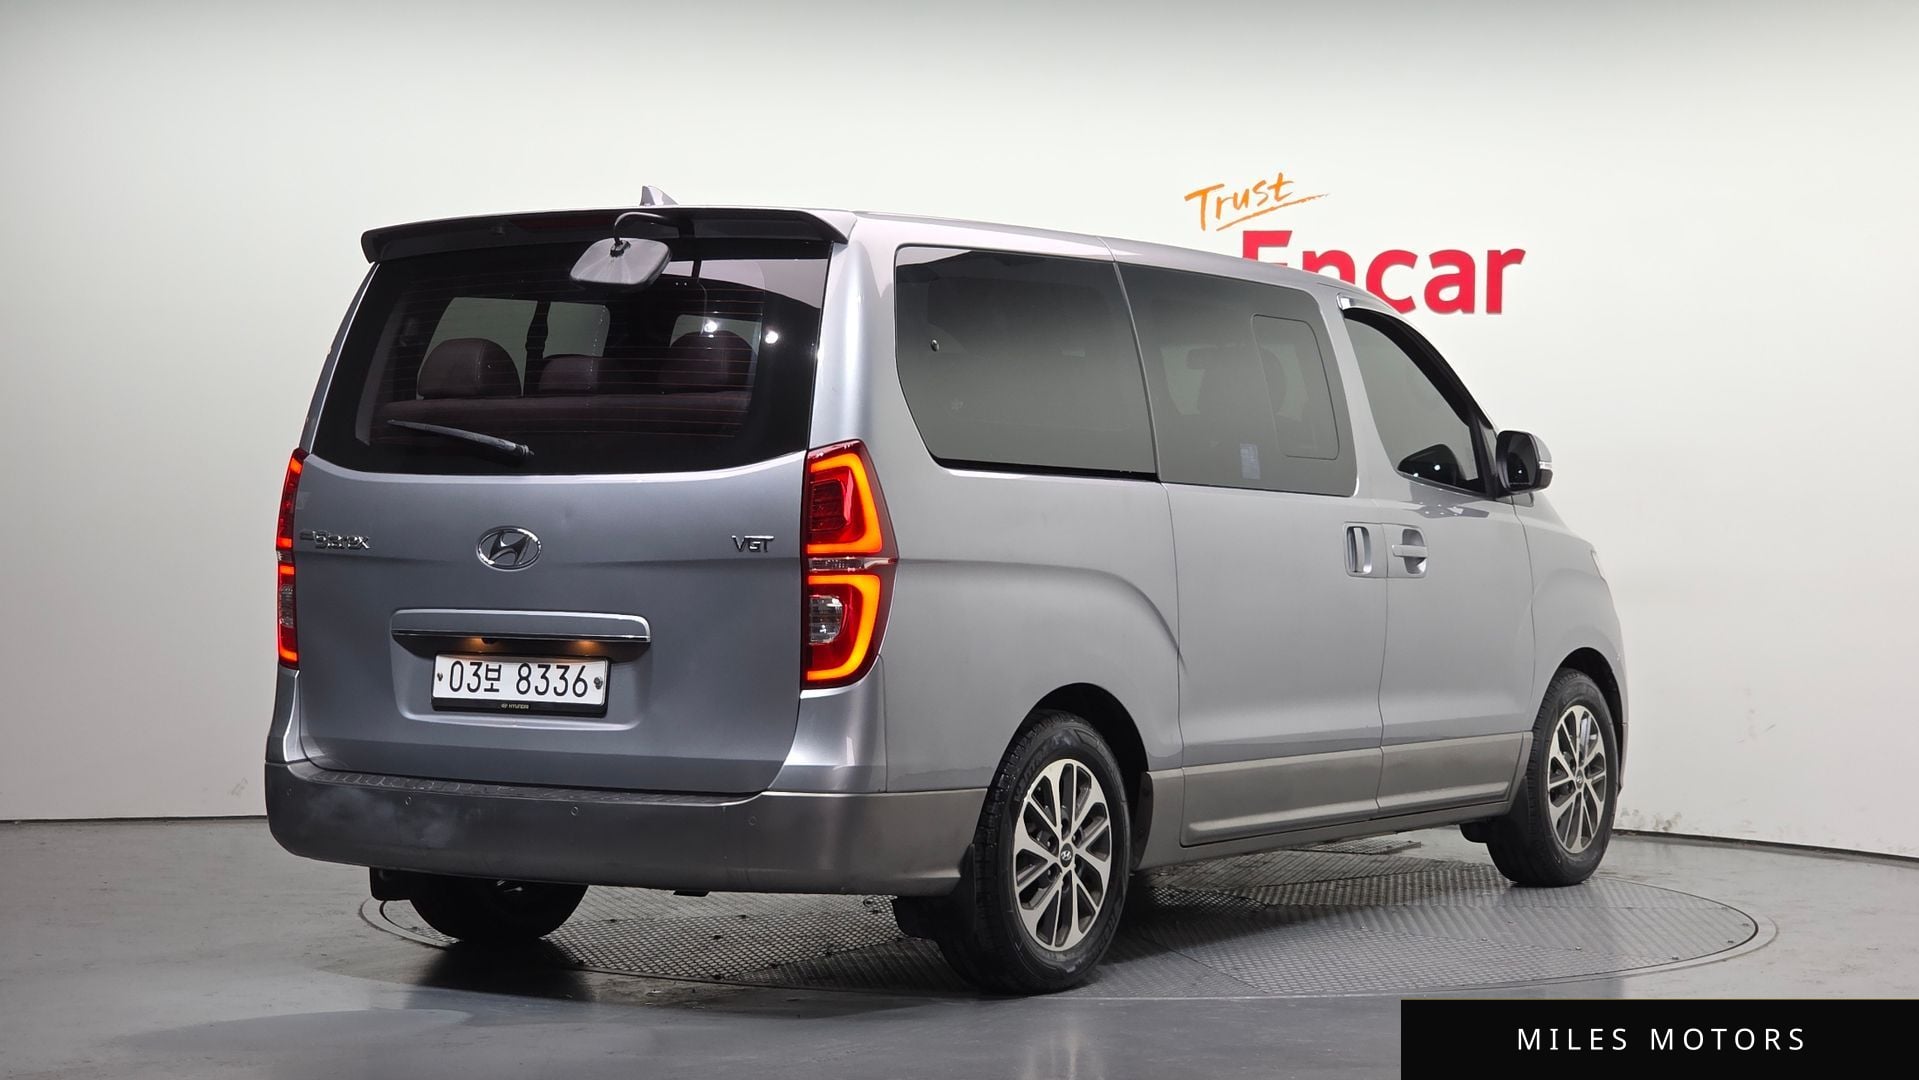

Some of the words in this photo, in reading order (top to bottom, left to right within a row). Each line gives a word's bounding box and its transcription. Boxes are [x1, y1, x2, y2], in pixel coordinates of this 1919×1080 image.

[1184, 172, 1295, 231] Trust
[731, 535, 774, 553] VGT
[449, 660, 502, 693] 03보
[516, 662, 588, 698] 8336
